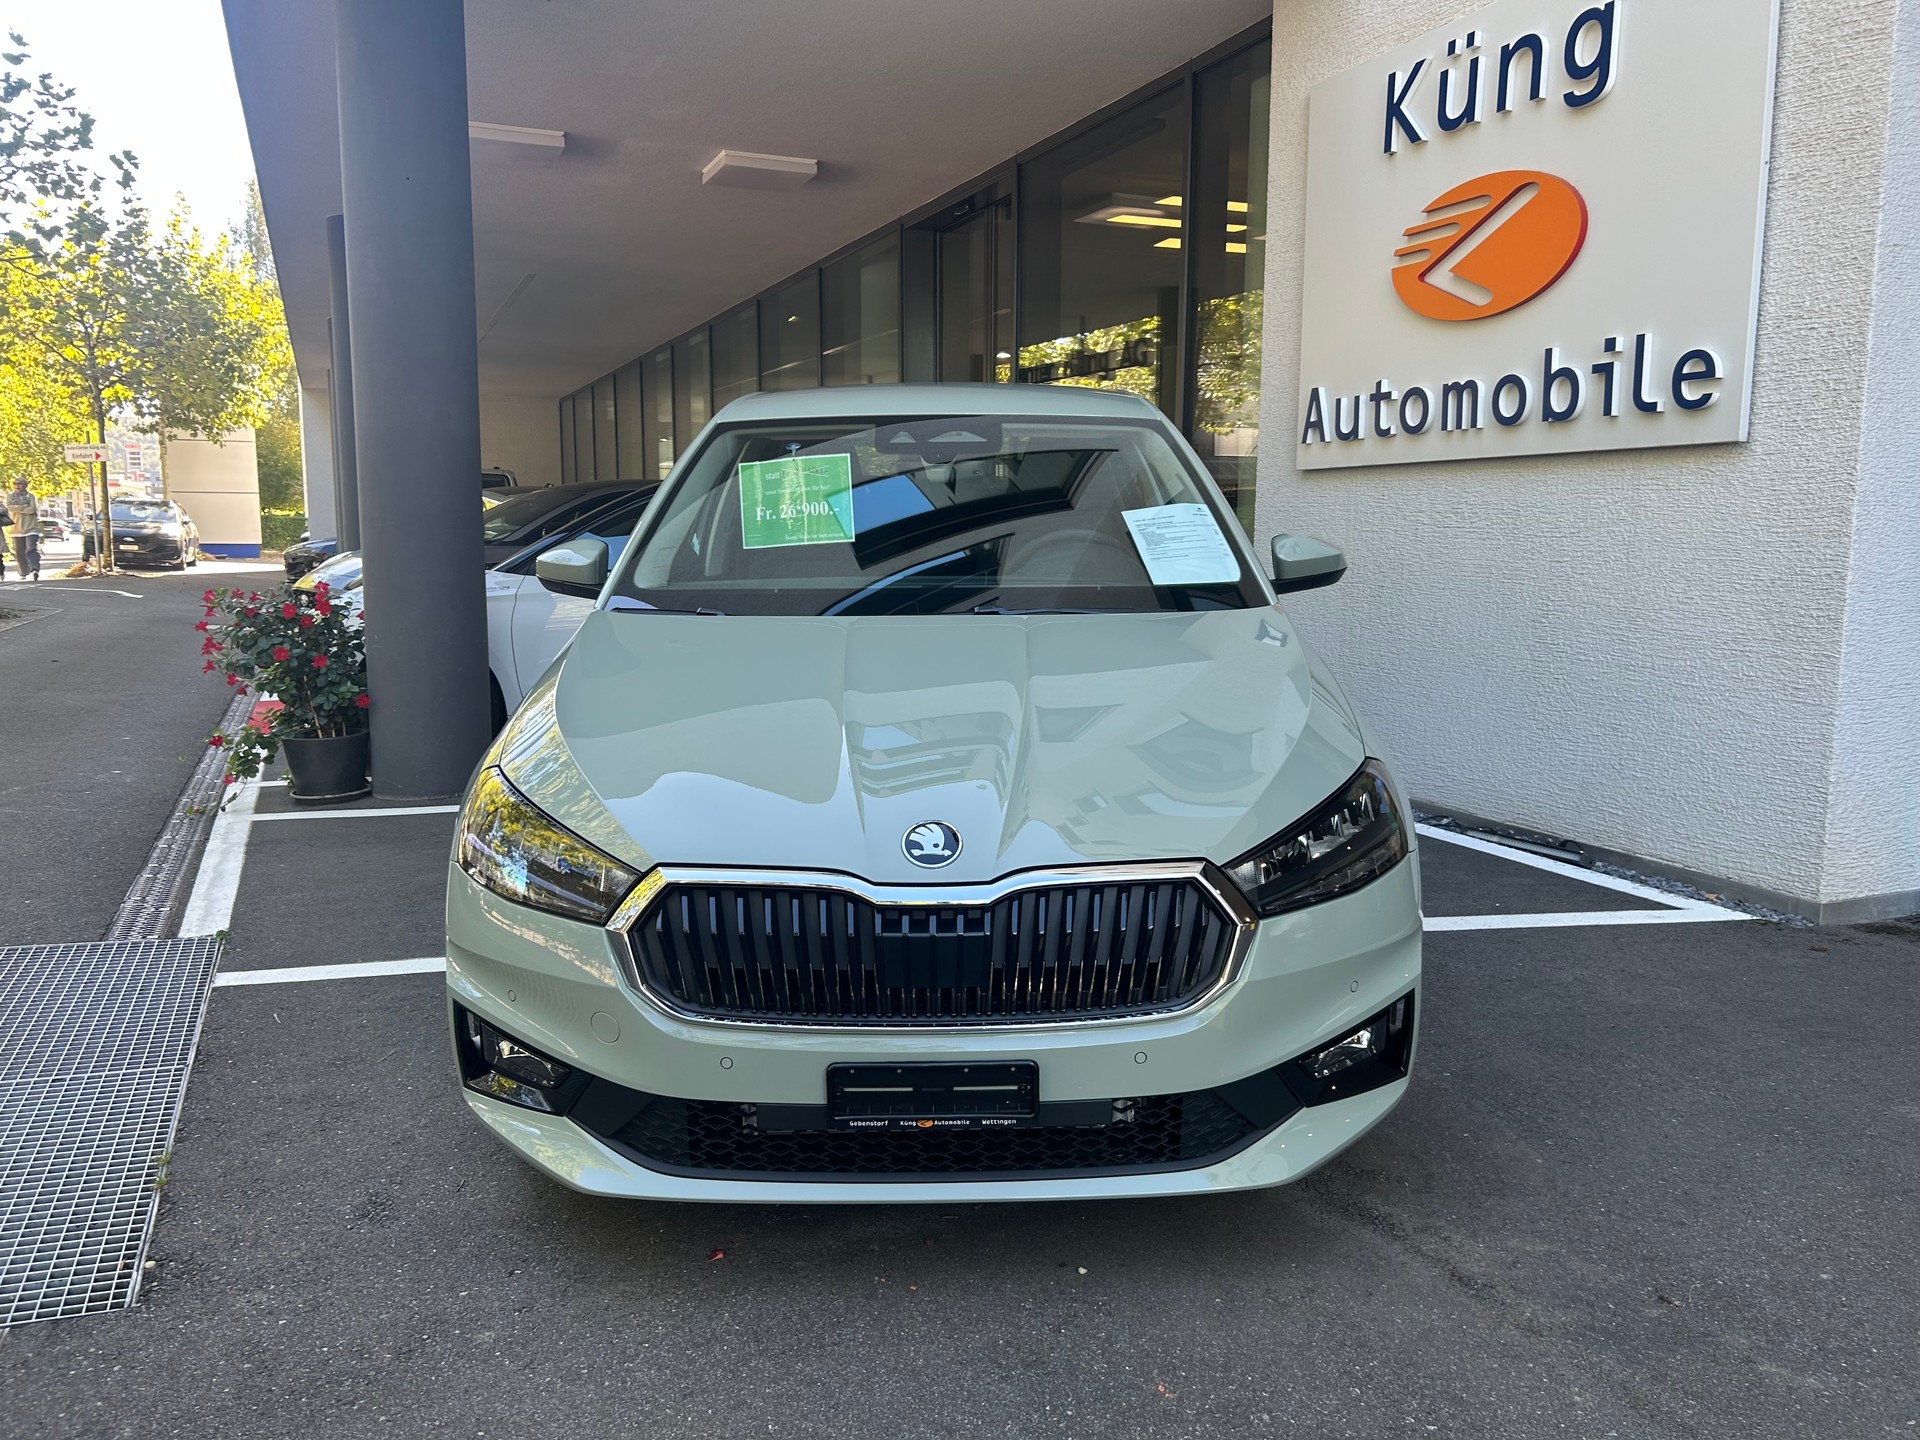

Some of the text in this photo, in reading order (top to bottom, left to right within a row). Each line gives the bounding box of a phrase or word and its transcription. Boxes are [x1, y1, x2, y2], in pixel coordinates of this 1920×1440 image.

[1383, 0, 1621, 155] Küng
[1301, 333, 1724, 445] Automobile
[765, 472, 781, 481] statt
[756, 507, 776, 521] Fr.
[849, 1119, 889, 1127] Gebenstorf
